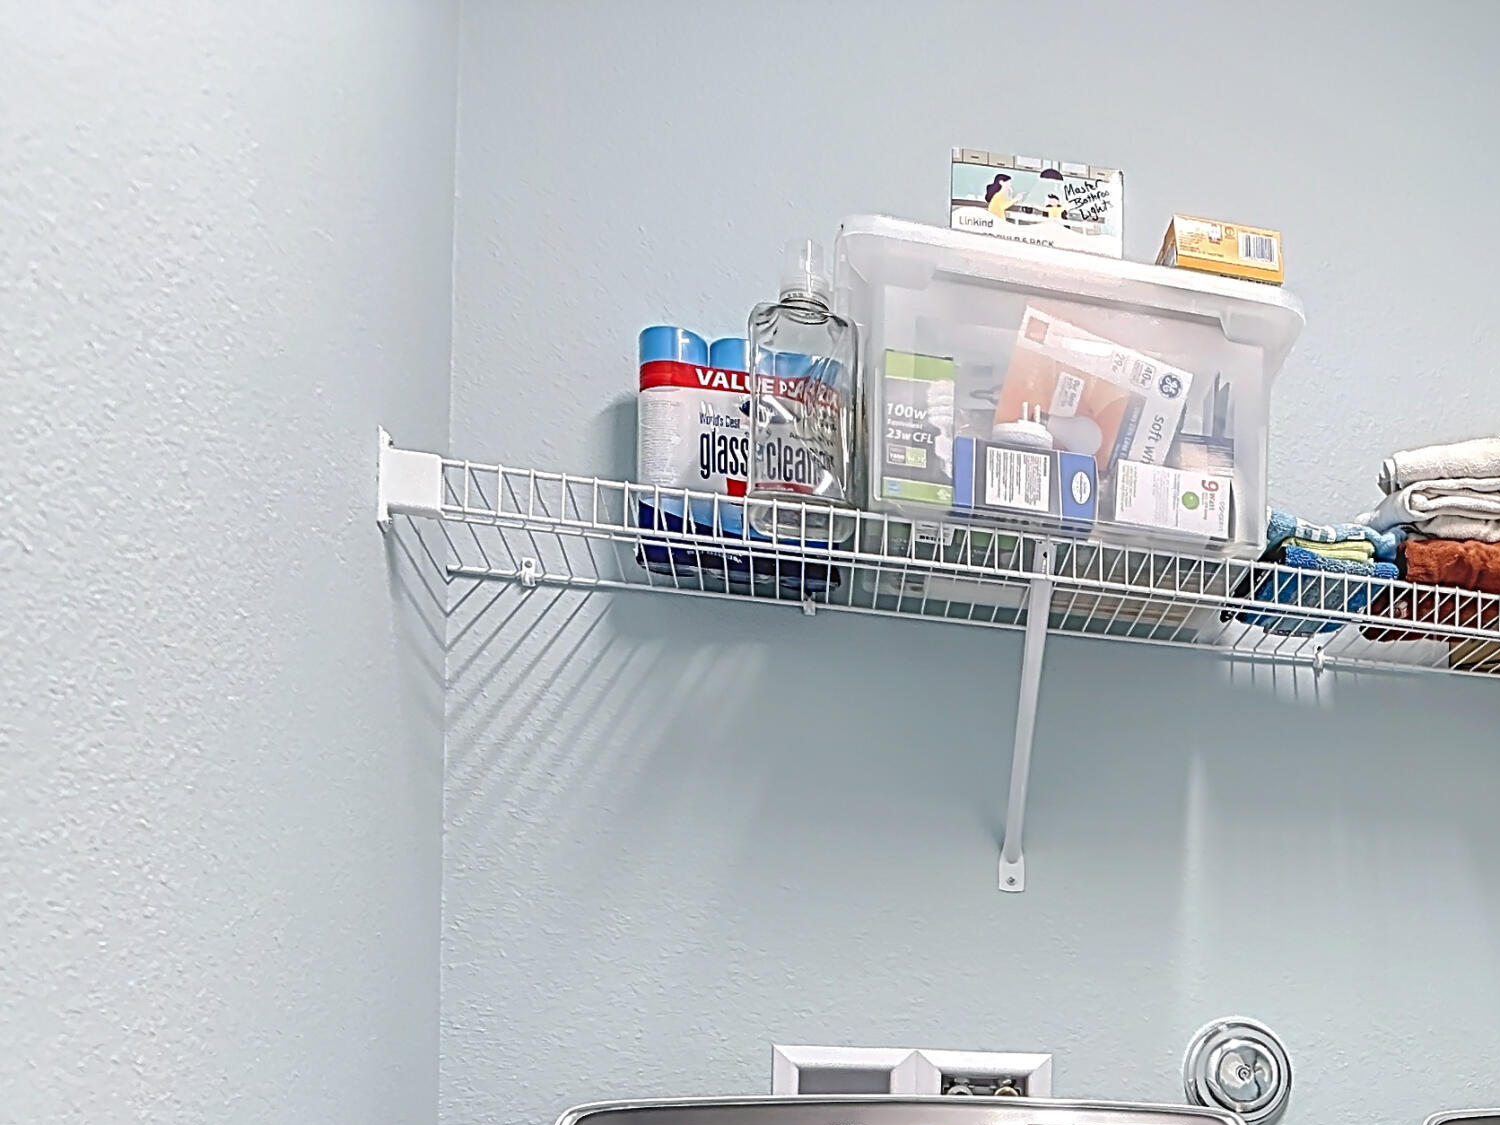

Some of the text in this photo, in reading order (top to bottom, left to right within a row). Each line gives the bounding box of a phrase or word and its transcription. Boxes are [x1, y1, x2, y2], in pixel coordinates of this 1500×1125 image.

[1064, 179, 1103, 201] Master
[959, 215, 994, 228] Linkind
[695, 368, 775, 394] VALUE
[912, 432, 935, 444] CFL
[1148, 415, 1165, 445] soft
[700, 428, 750, 480] glass
[1201, 479, 1219, 493] 9
